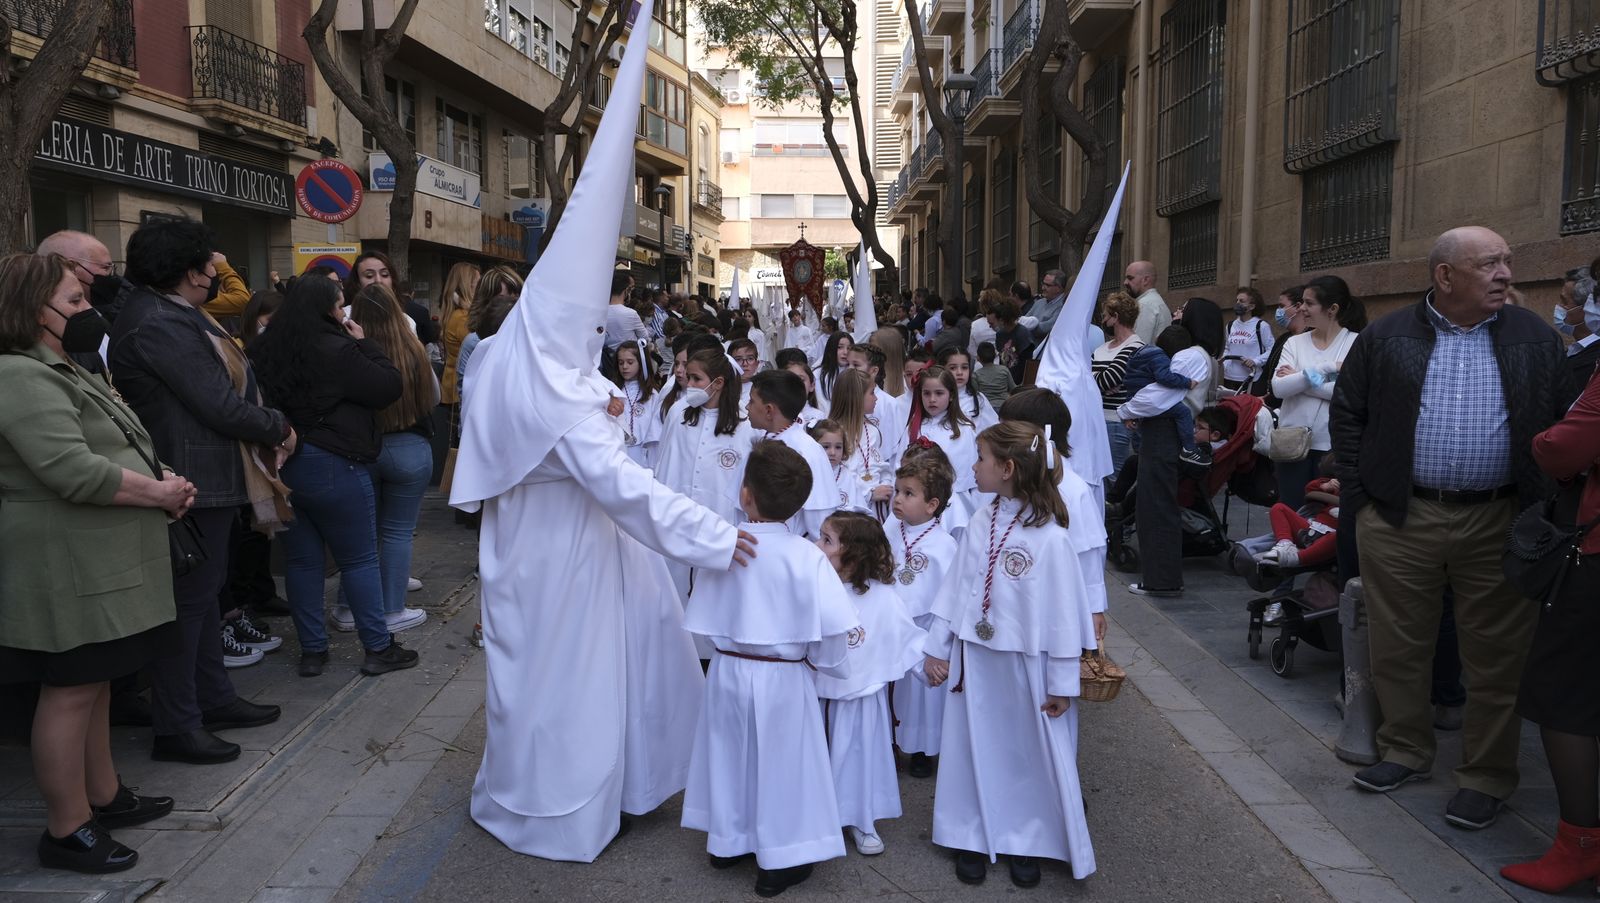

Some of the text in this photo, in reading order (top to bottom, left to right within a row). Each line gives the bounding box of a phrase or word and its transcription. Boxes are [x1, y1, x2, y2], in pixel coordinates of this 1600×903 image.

[37, 120, 289, 207] LERIA DE ARTE TRINO TORTOSA
[310, 160, 344, 170] EXCEPTO
[434, 178, 463, 196] ALMICRAR
[298, 187, 312, 212] MEDIOS
[312, 209, 322, 219] DE
